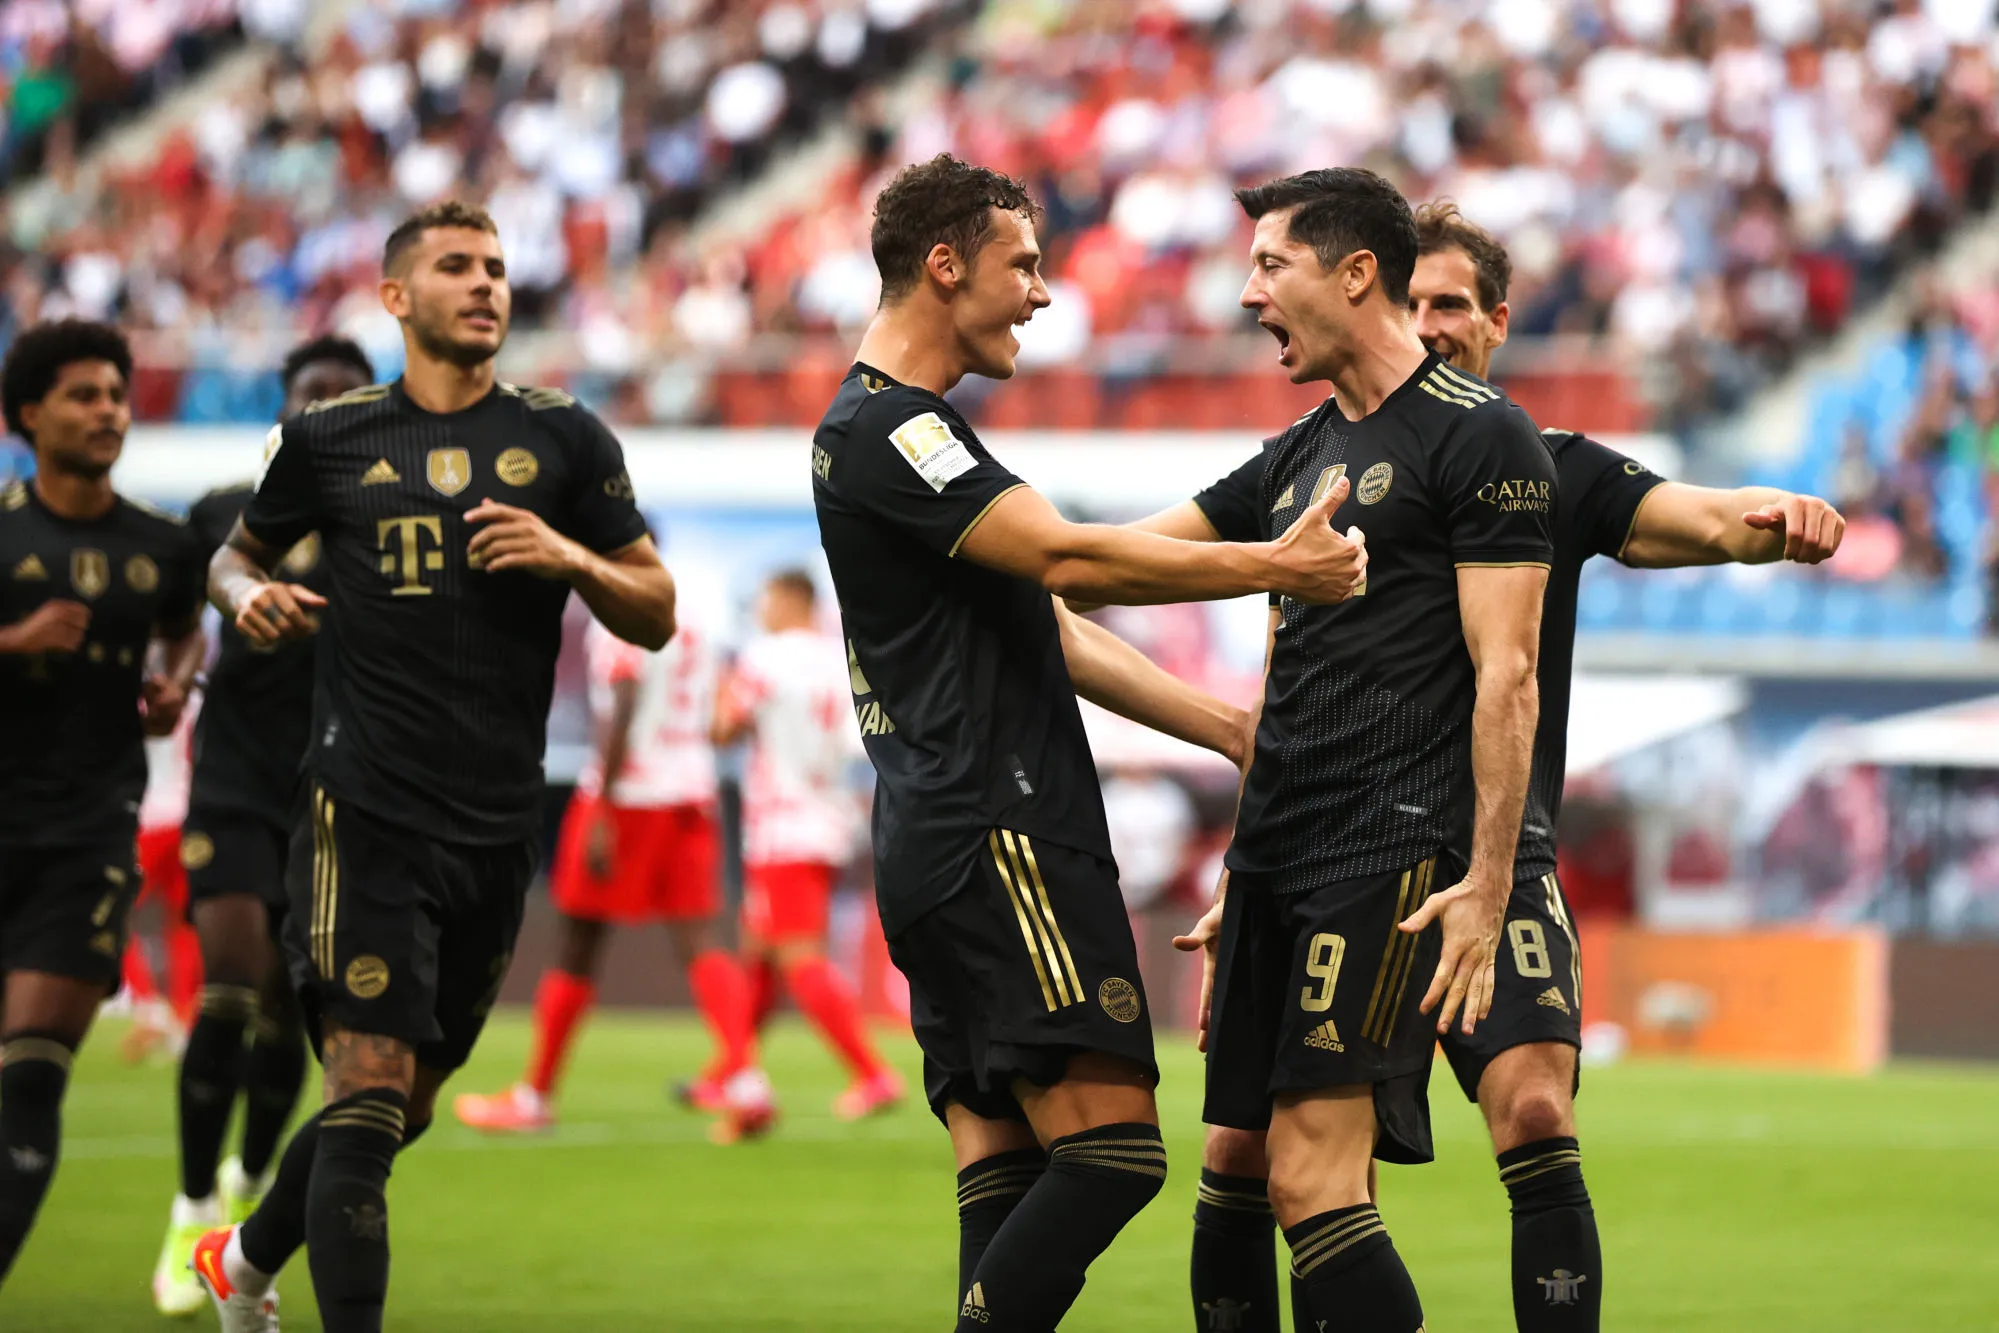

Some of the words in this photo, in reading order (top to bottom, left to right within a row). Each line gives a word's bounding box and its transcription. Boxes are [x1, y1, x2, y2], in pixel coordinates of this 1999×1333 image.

[918, 441, 959, 471] BUNDESLIGA
[1477, 480, 1550, 505] QATAR
[1499, 499, 1549, 514] AIRWAYS
[1507, 919, 1552, 979] 8
[1300, 932, 1346, 1012] 9
[1303, 1034, 1345, 1053] adidas
